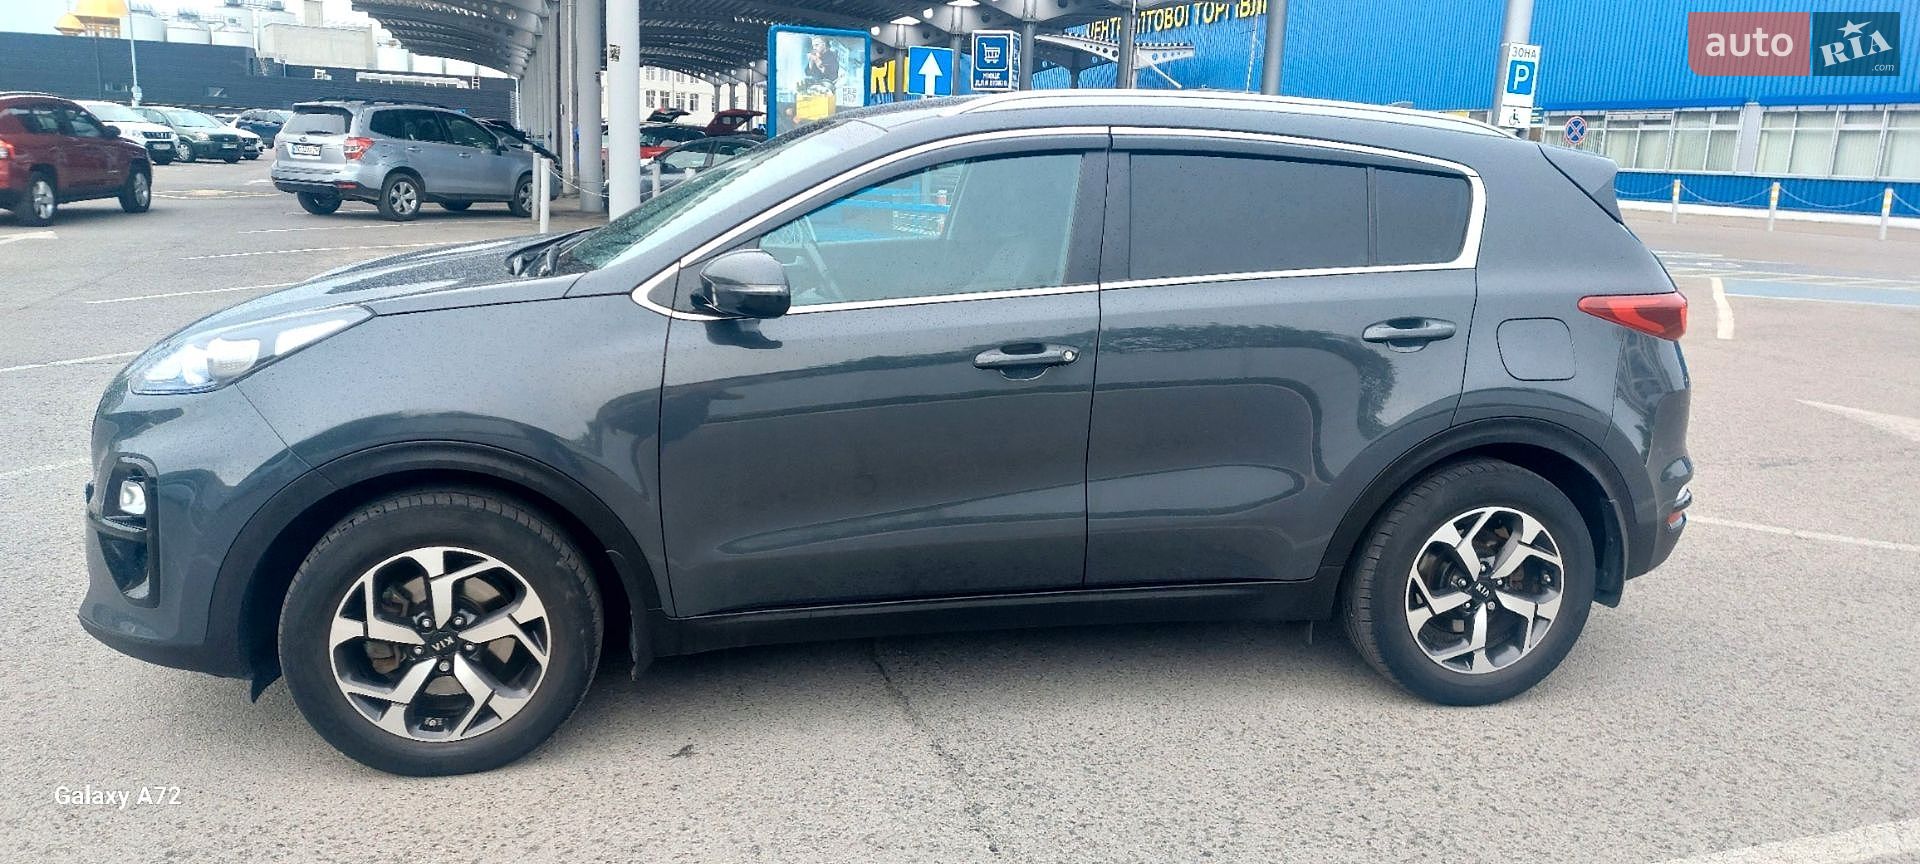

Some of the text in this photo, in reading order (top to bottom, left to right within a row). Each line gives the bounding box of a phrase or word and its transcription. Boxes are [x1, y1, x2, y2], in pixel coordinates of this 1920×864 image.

[1511, 47, 1537, 58] ЗОНА
[1513, 64, 1530, 90] P
[1475, 583, 1490, 598] KIA
[431, 636, 455, 651] KIA
